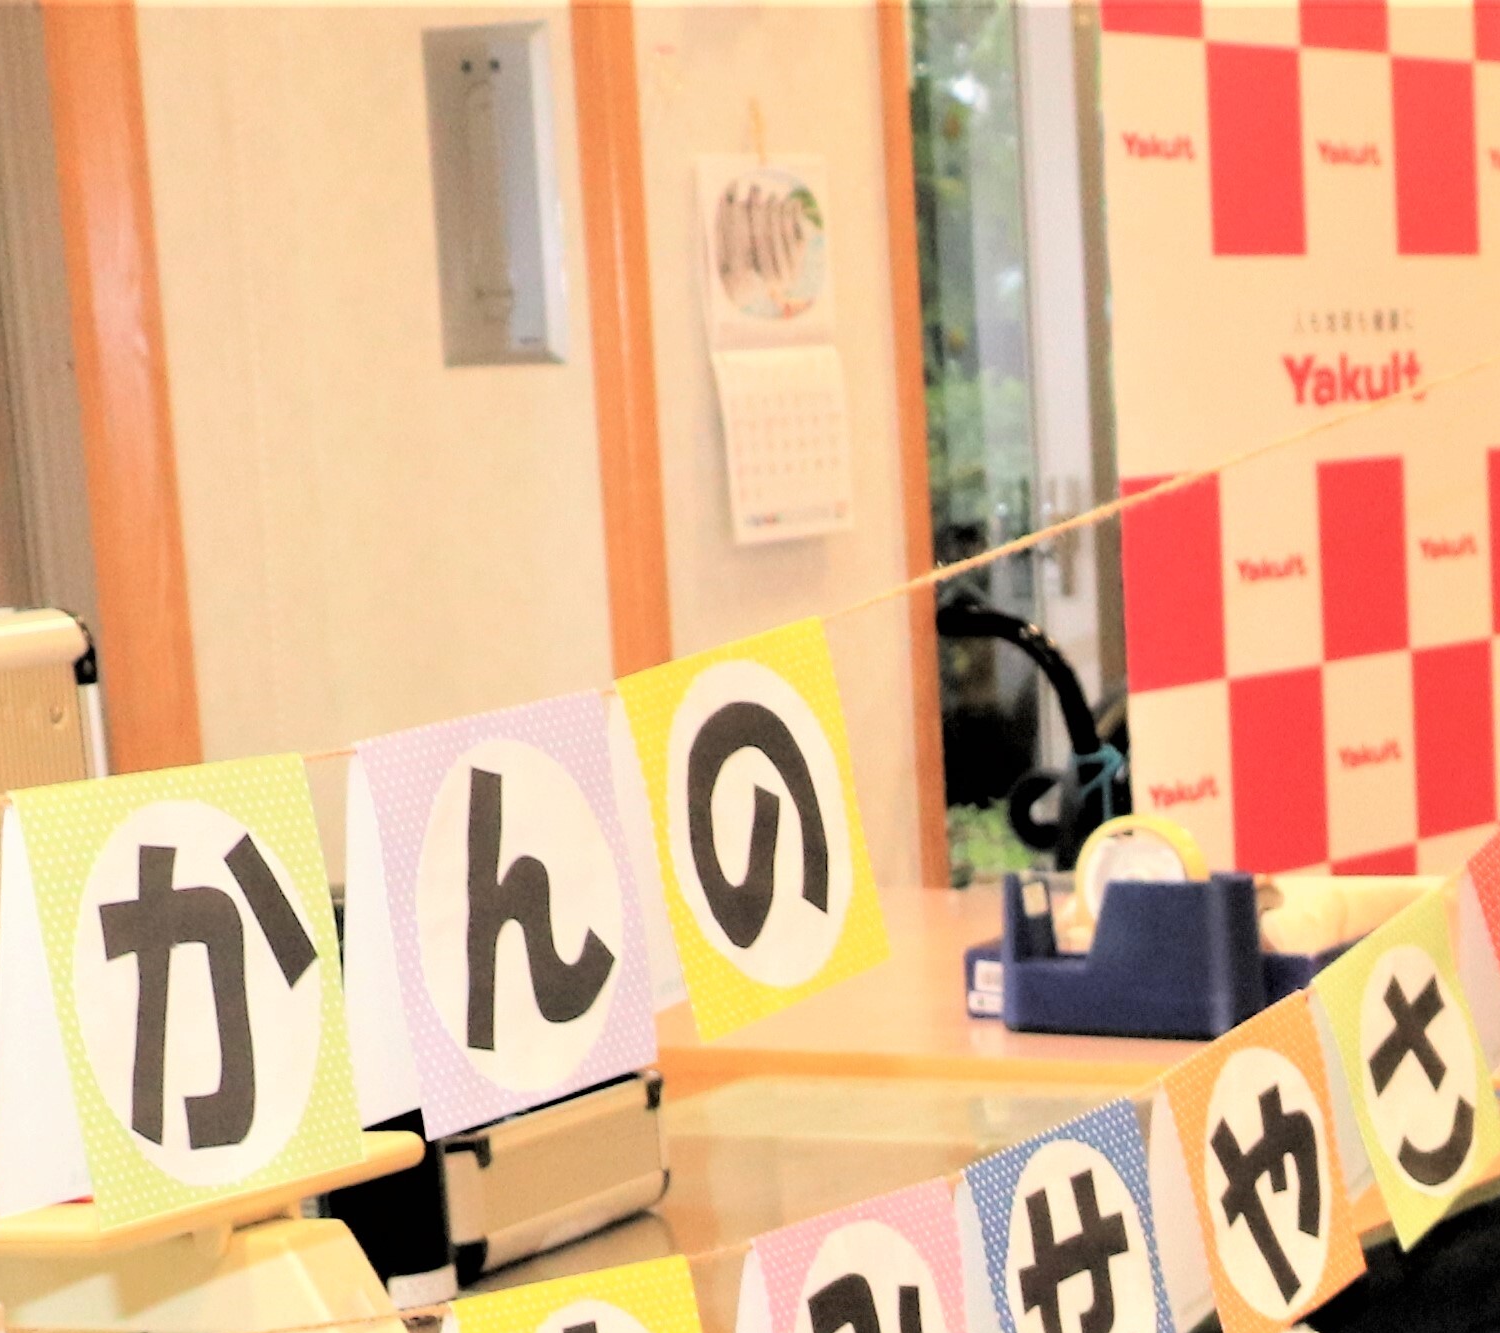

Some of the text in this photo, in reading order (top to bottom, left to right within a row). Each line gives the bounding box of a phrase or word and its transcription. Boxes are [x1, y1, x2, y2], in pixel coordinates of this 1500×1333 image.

[1122, 132, 1195, 162] Yakult
[1316, 139, 1381, 166] Yakult
[1283, 349, 1427, 406] Yakult
[1419, 535, 1477, 560] Yakult
[1236, 554, 1307, 582] Yakult
[1339, 740, 1401, 769] Yakult
[1149, 775, 1219, 809] Yakult
